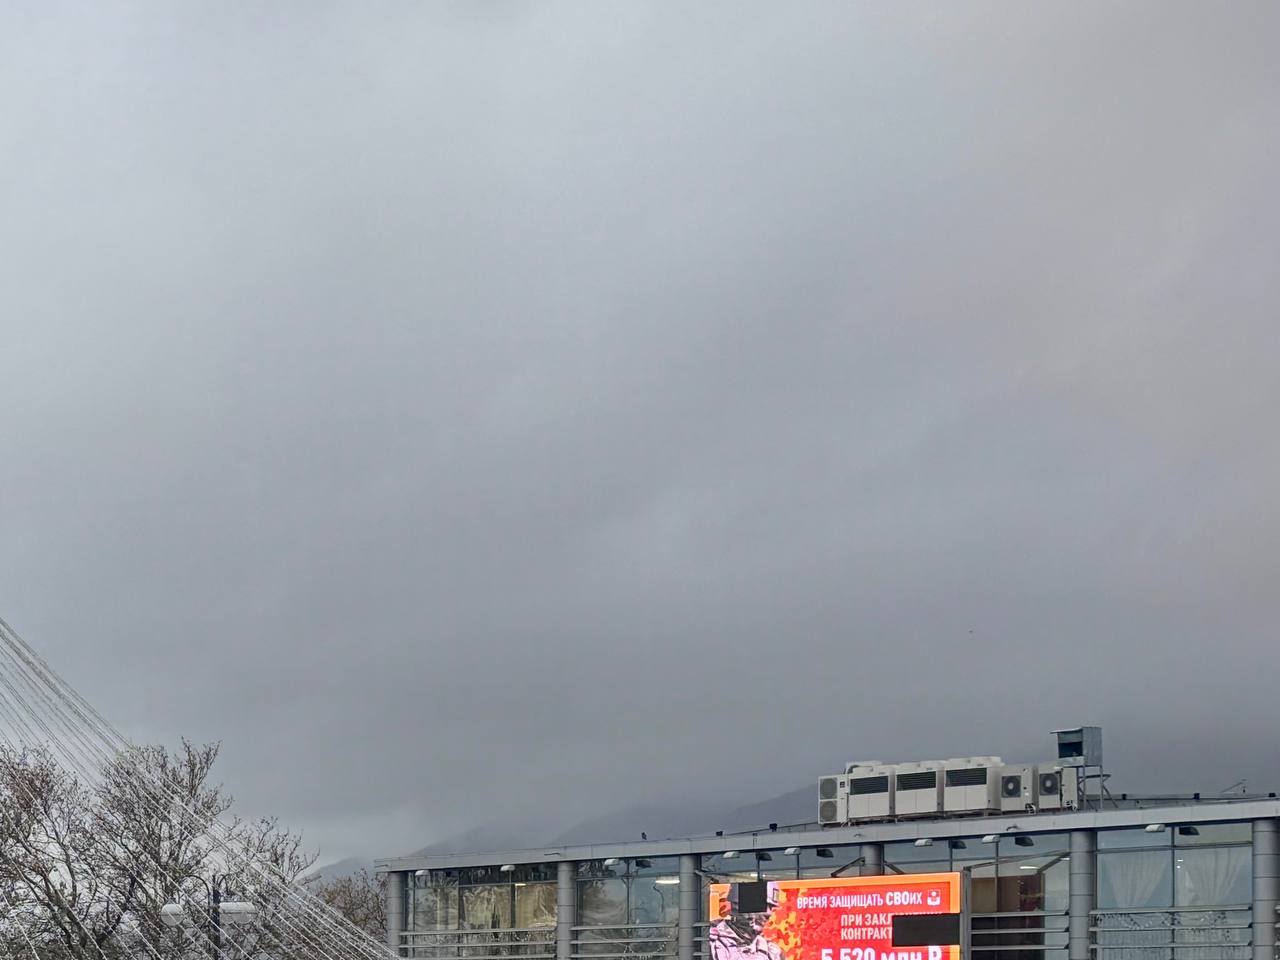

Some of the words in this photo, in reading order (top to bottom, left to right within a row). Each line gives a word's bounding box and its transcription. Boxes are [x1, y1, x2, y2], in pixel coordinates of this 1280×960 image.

[797, 896, 827, 909] ВРЕМЯ
[830, 893, 883, 908] ЗАЩИЩАТЬ
[841, 913, 862, 927] ПРИ
